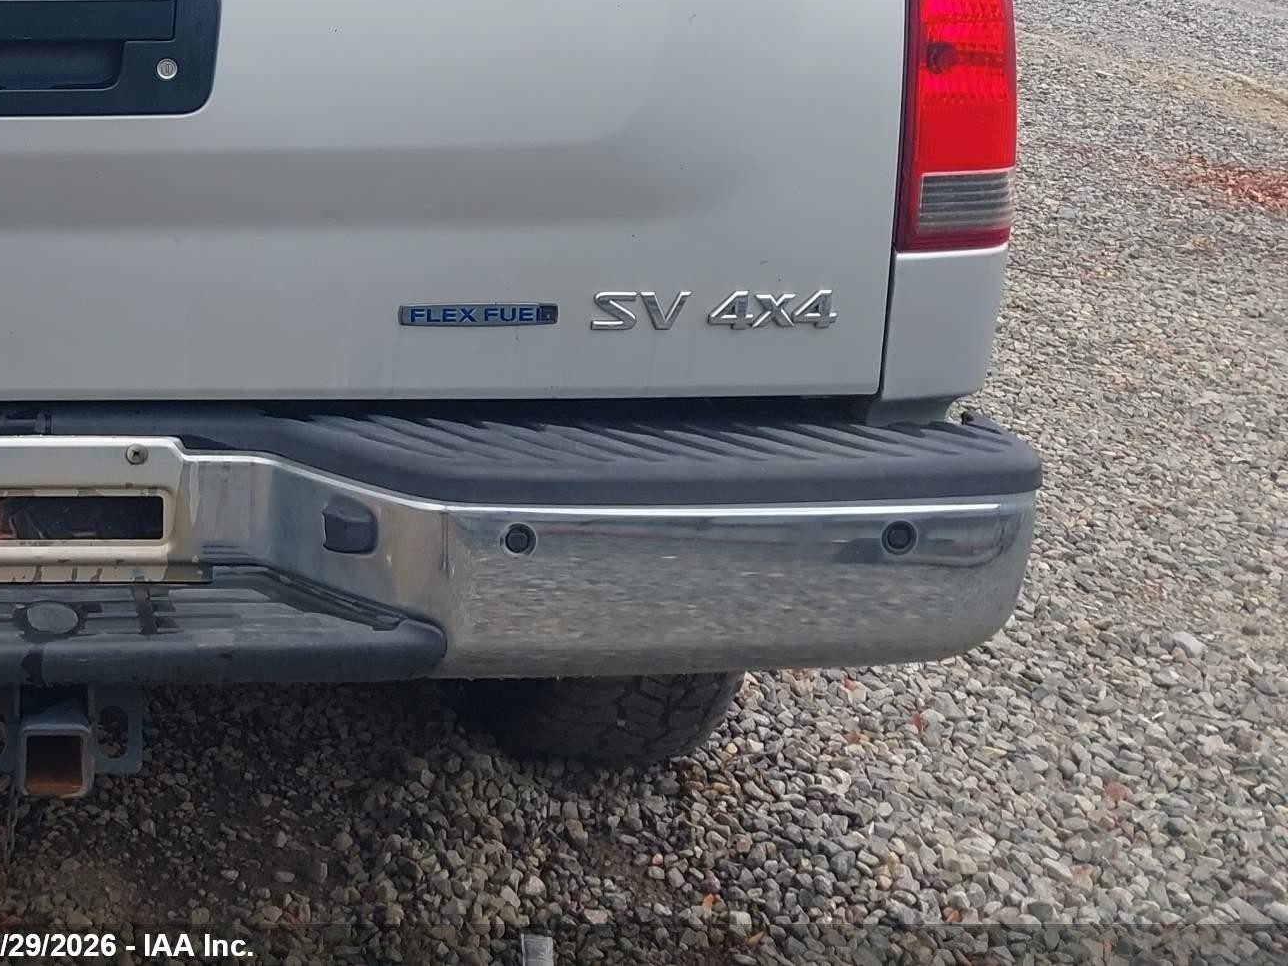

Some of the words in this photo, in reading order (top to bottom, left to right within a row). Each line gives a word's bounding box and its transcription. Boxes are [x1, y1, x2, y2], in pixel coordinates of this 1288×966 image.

[410, 307, 478, 323] FLEX
[483, 306, 551, 322] FUEL
[590, 290, 693, 331] SV
